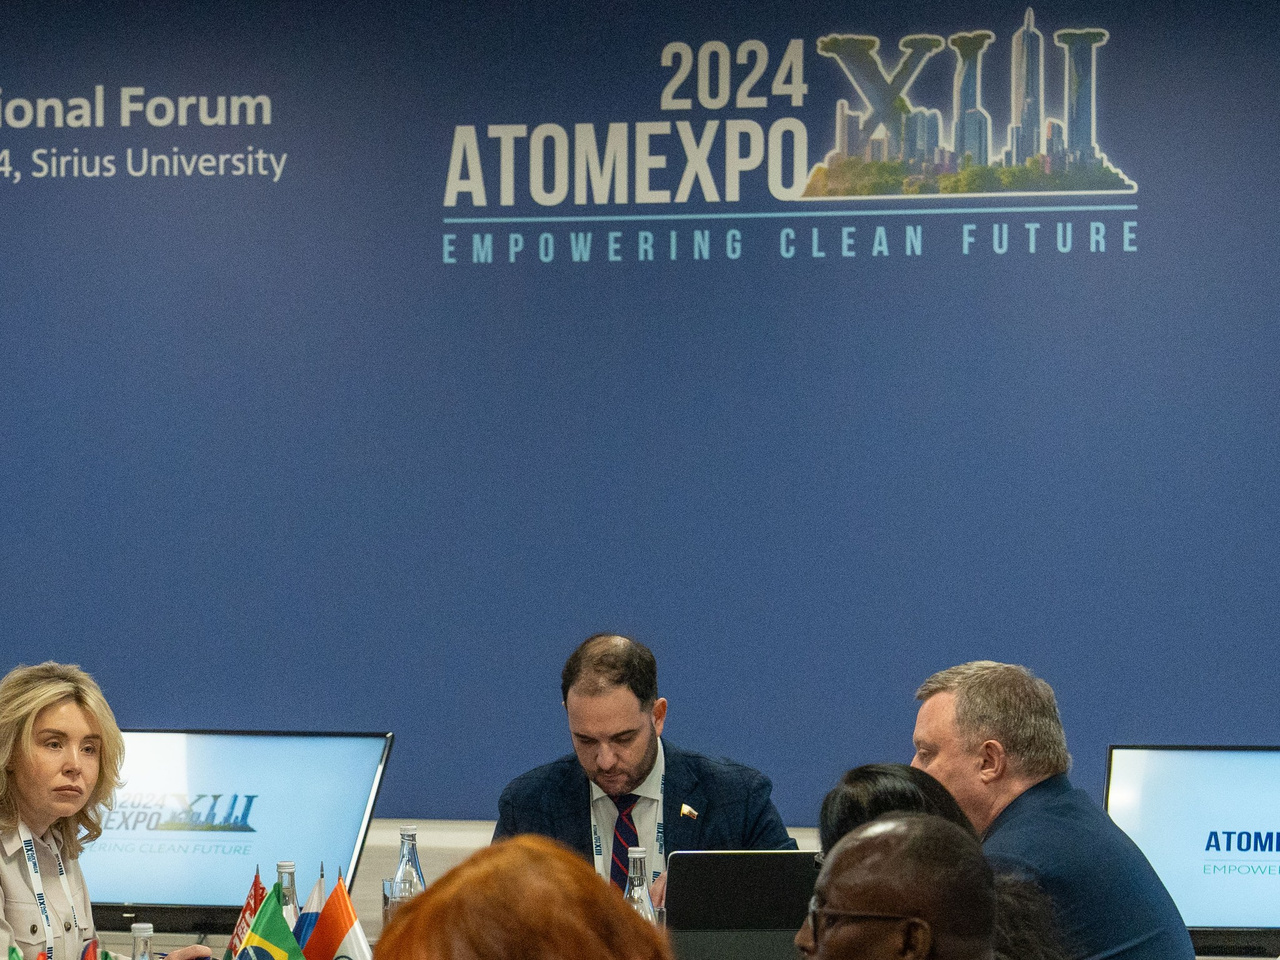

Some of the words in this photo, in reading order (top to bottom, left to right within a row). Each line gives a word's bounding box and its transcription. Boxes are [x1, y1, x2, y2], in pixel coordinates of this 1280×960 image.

[660, 39, 809, 110] 2024
[120, 87, 272, 127] Forum
[32, 148, 116, 178] Sirius
[126, 145, 288, 182] University
[443, 117, 810, 207] ATOMEXPO
[442, 229, 742, 264] EMPOWERING
[779, 225, 923, 259] CLEAN
[961, 220, 1139, 256] FUTURE
[103, 811, 162, 831] EXPO
[192, 843, 253, 856] FUTURE
[1203, 864, 1280, 875] EMPOWE
